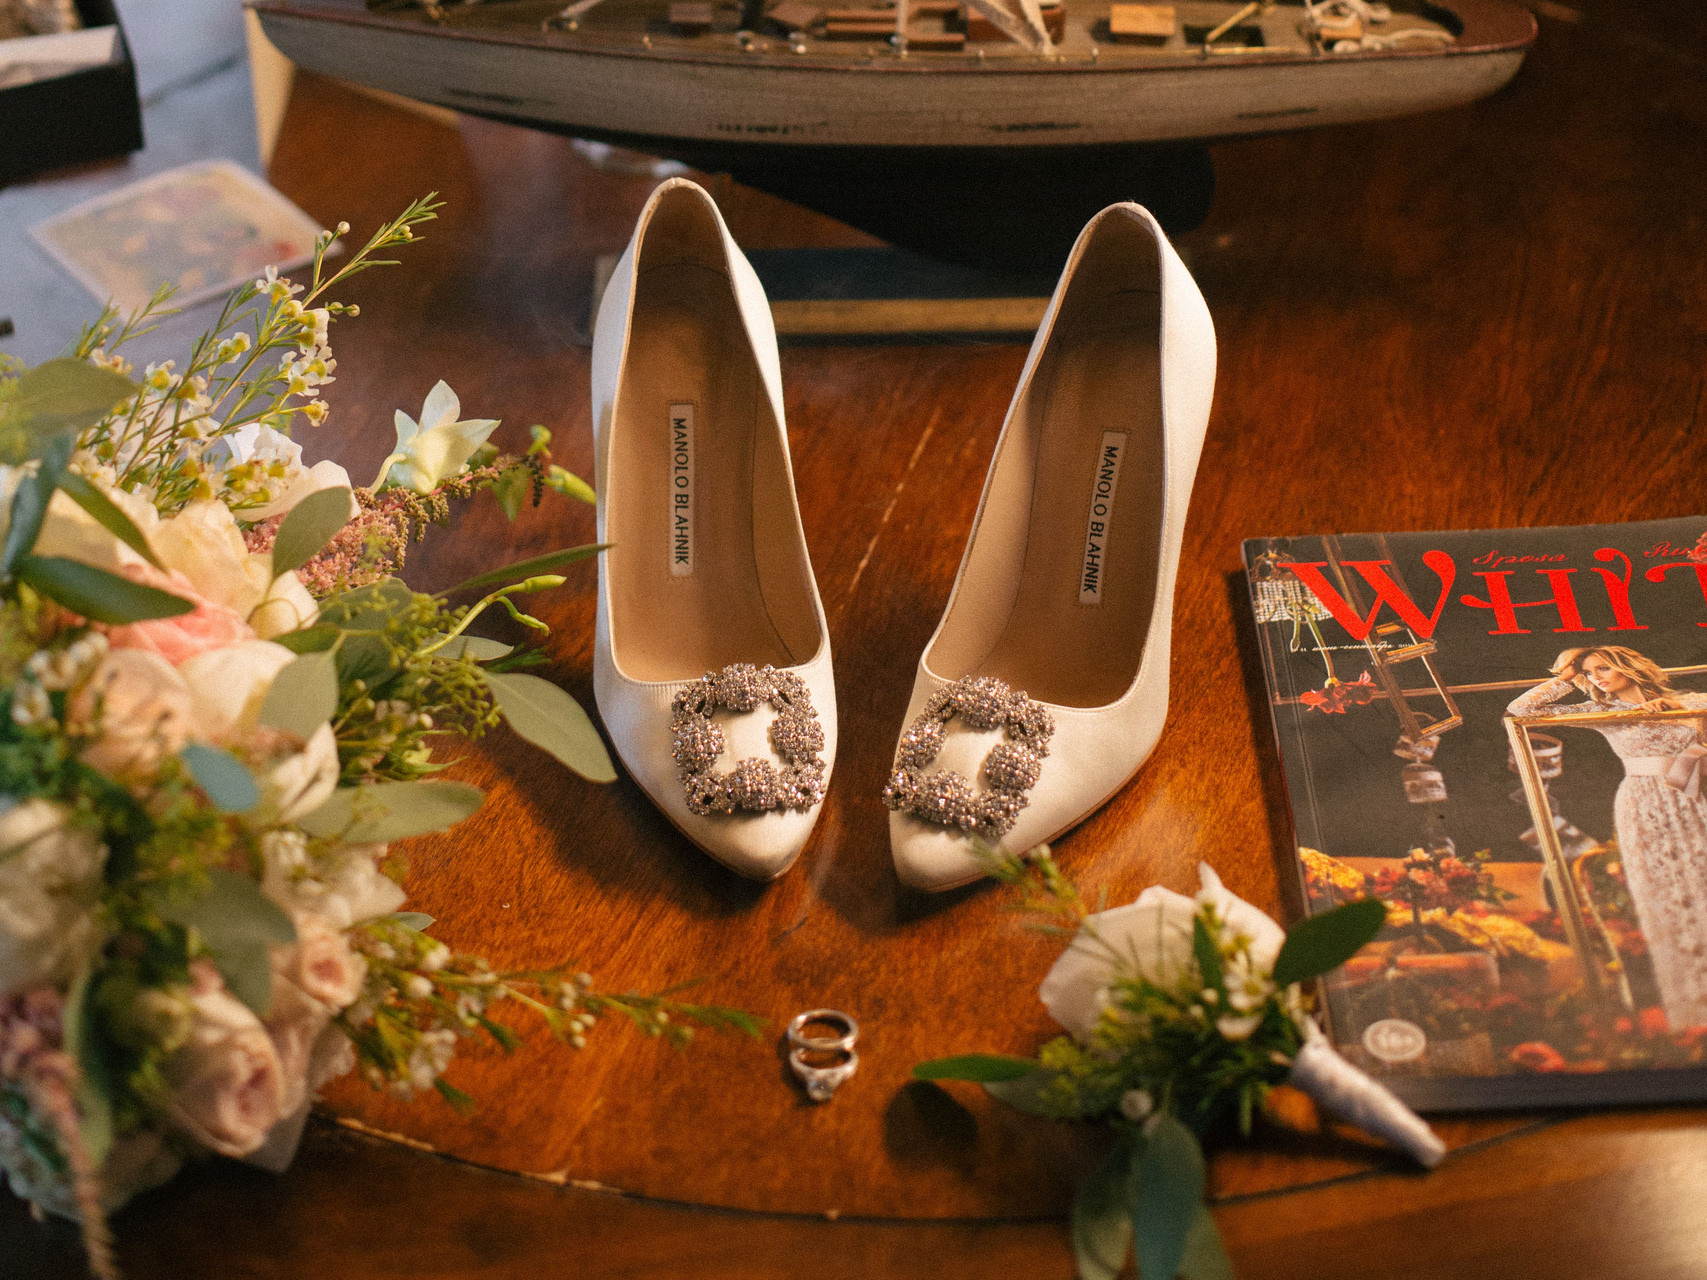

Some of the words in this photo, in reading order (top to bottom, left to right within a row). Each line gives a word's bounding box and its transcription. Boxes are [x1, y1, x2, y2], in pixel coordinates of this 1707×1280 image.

[673, 418, 689, 489] MANOLO
[1093, 445, 1119, 517] MANOLO
[674, 493, 690, 565] BLAHNIK
[1083, 521, 1105, 594] BLAHNIK
[1472, 549, 1570, 569] Sposa
